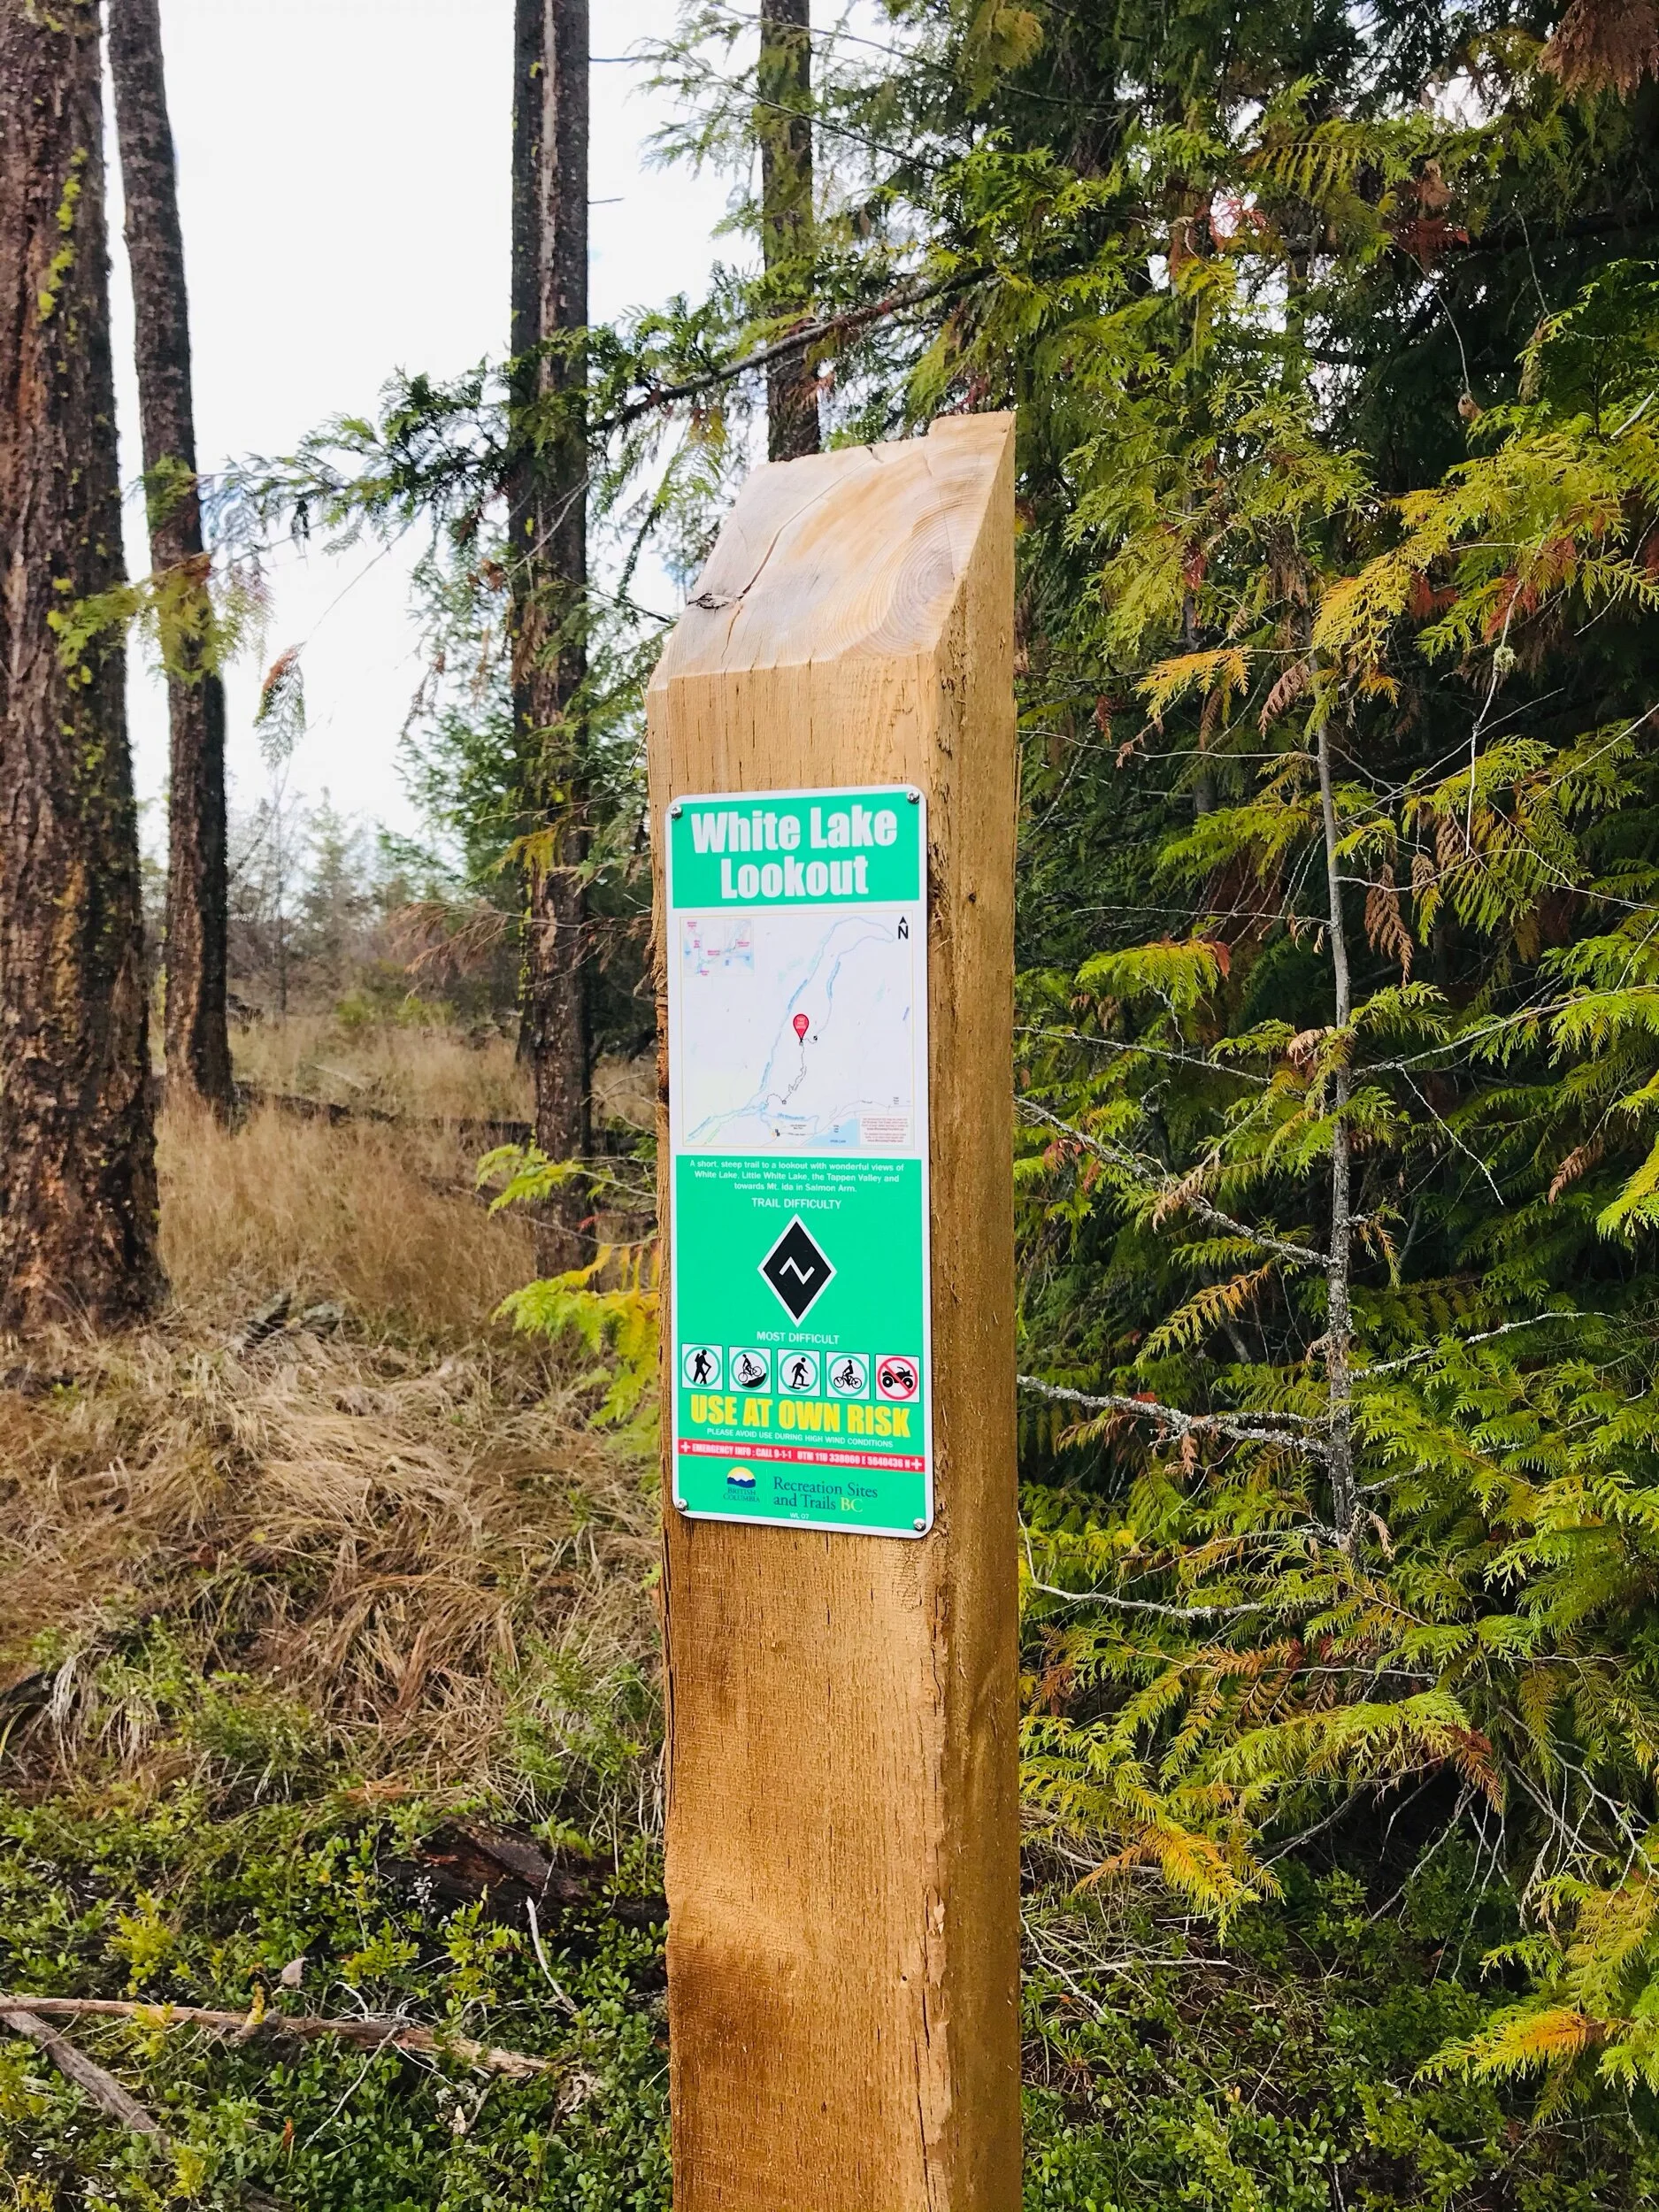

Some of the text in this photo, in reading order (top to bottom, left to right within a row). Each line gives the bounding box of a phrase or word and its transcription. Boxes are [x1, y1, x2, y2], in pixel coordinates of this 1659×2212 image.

[690, 804, 897, 854] White Lake
[720, 855, 869, 899] Lookout
[898, 926, 909, 940] N
[721, 1161, 742, 1170] steep
[826, 1172, 856, 1182] Tappen
[858, 1174, 881, 1184] Valley
[805, 1183, 836, 1192] Salmon
[838, 1184, 857, 1193] Arm.
[751, 1197, 841, 1210] TRAIL DIFFICULTY
[757, 1331, 840, 1345] MOST DIFFICULT
[690, 1394, 911, 1438] USE AT OWN RISK
[707, 1428, 733, 1437] PLEASE
[735, 1429, 757, 1438] AVOID
[759, 1431, 773, 1440] USE
[774, 1432, 803, 1441] DURING
[847, 1438, 894, 1448] CONDITIONS
[692, 1443, 733, 1455] EMERGENCY
[734, 1446, 751, 1456] INFO
[756, 1448, 772, 1458] CALL
[774, 1448, 792, 1459] 9-1-1
[773, 1476, 878, 1498] Recreation Sites
[723, 1493, 760, 1503] COLUMBIA
[773, 1493, 864, 1513] and Trails BC
